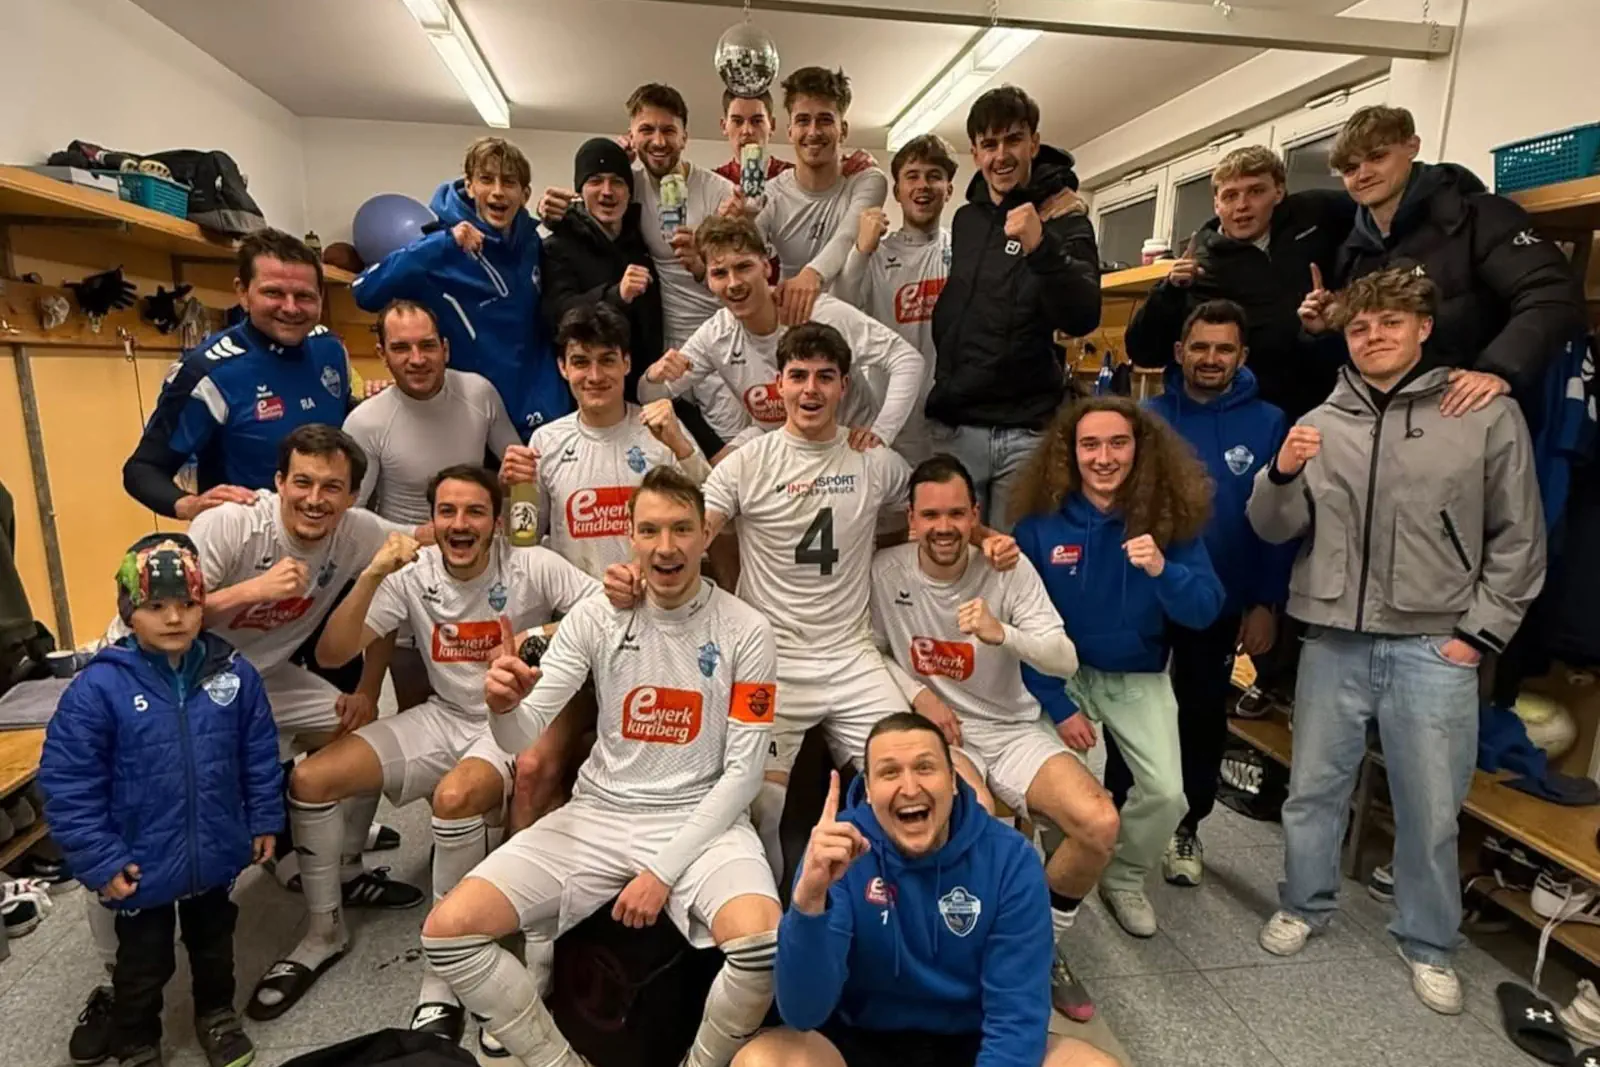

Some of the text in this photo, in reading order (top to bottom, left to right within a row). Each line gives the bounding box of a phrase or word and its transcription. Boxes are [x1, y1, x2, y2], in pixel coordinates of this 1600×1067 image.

[300, 397, 316, 411] RA
[525, 411, 544, 427] 23
[795, 507, 839, 576] 4
[133, 695, 149, 712] 5
[768, 741, 778, 758] 4
[1220, 758, 1264, 795] NIKE
[881, 909, 889, 925] 1
